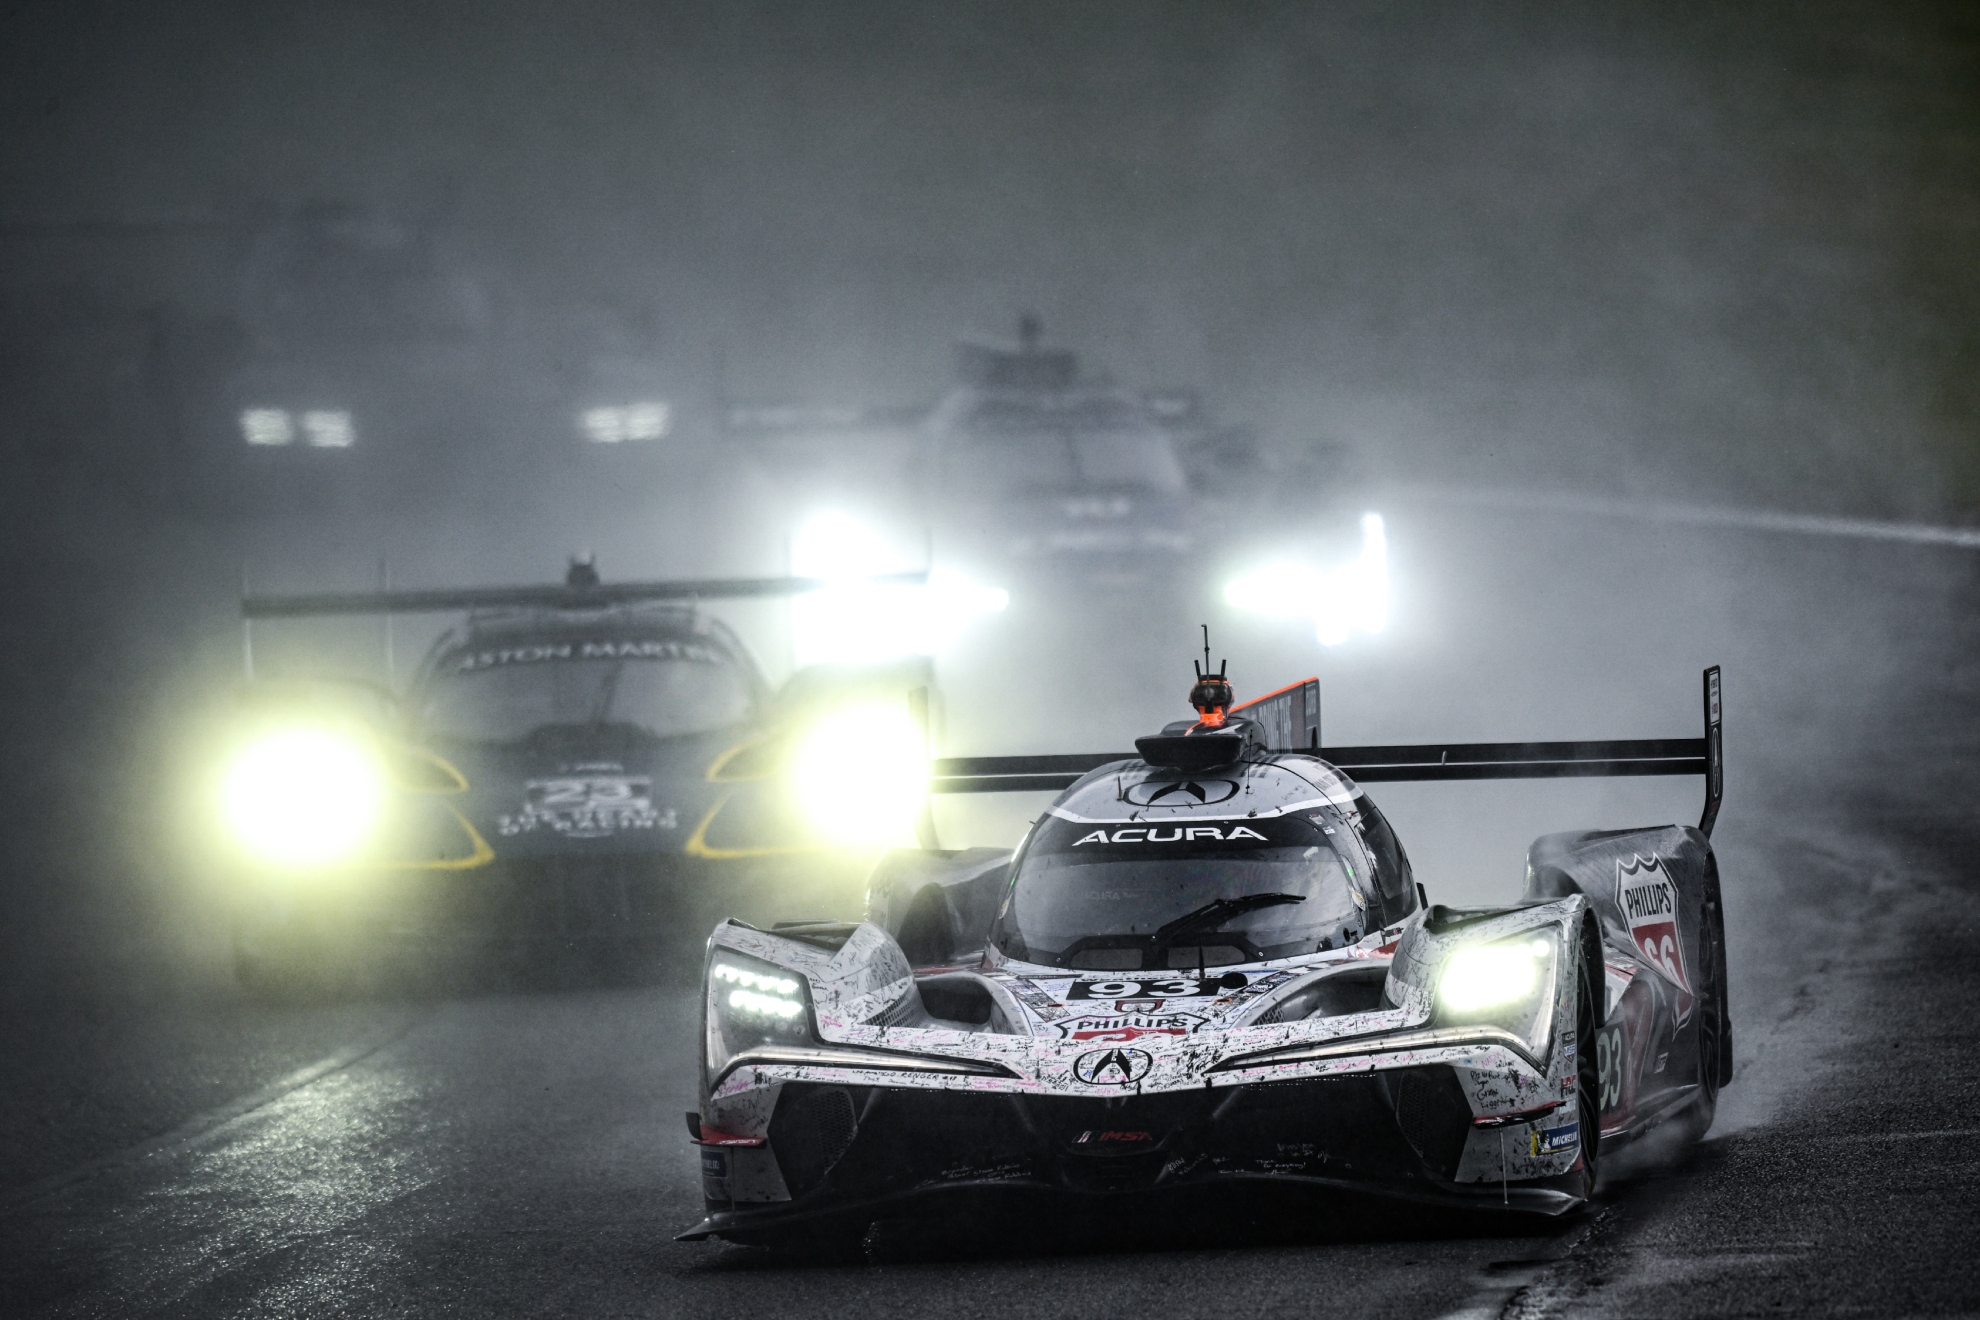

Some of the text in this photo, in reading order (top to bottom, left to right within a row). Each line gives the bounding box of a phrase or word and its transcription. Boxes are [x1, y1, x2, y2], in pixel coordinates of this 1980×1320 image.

[1071, 826, 1269, 847] ACURA
[1625, 882, 1672, 920] PHILLIPS
[1088, 979, 1202, 999] 93
[1077, 1015, 1188, 1030] PHILLIPS
[1597, 1027, 1622, 1110] 93
[1097, 1130, 1154, 1142] IMSA
[1551, 1130, 1577, 1147] MICHELIN
